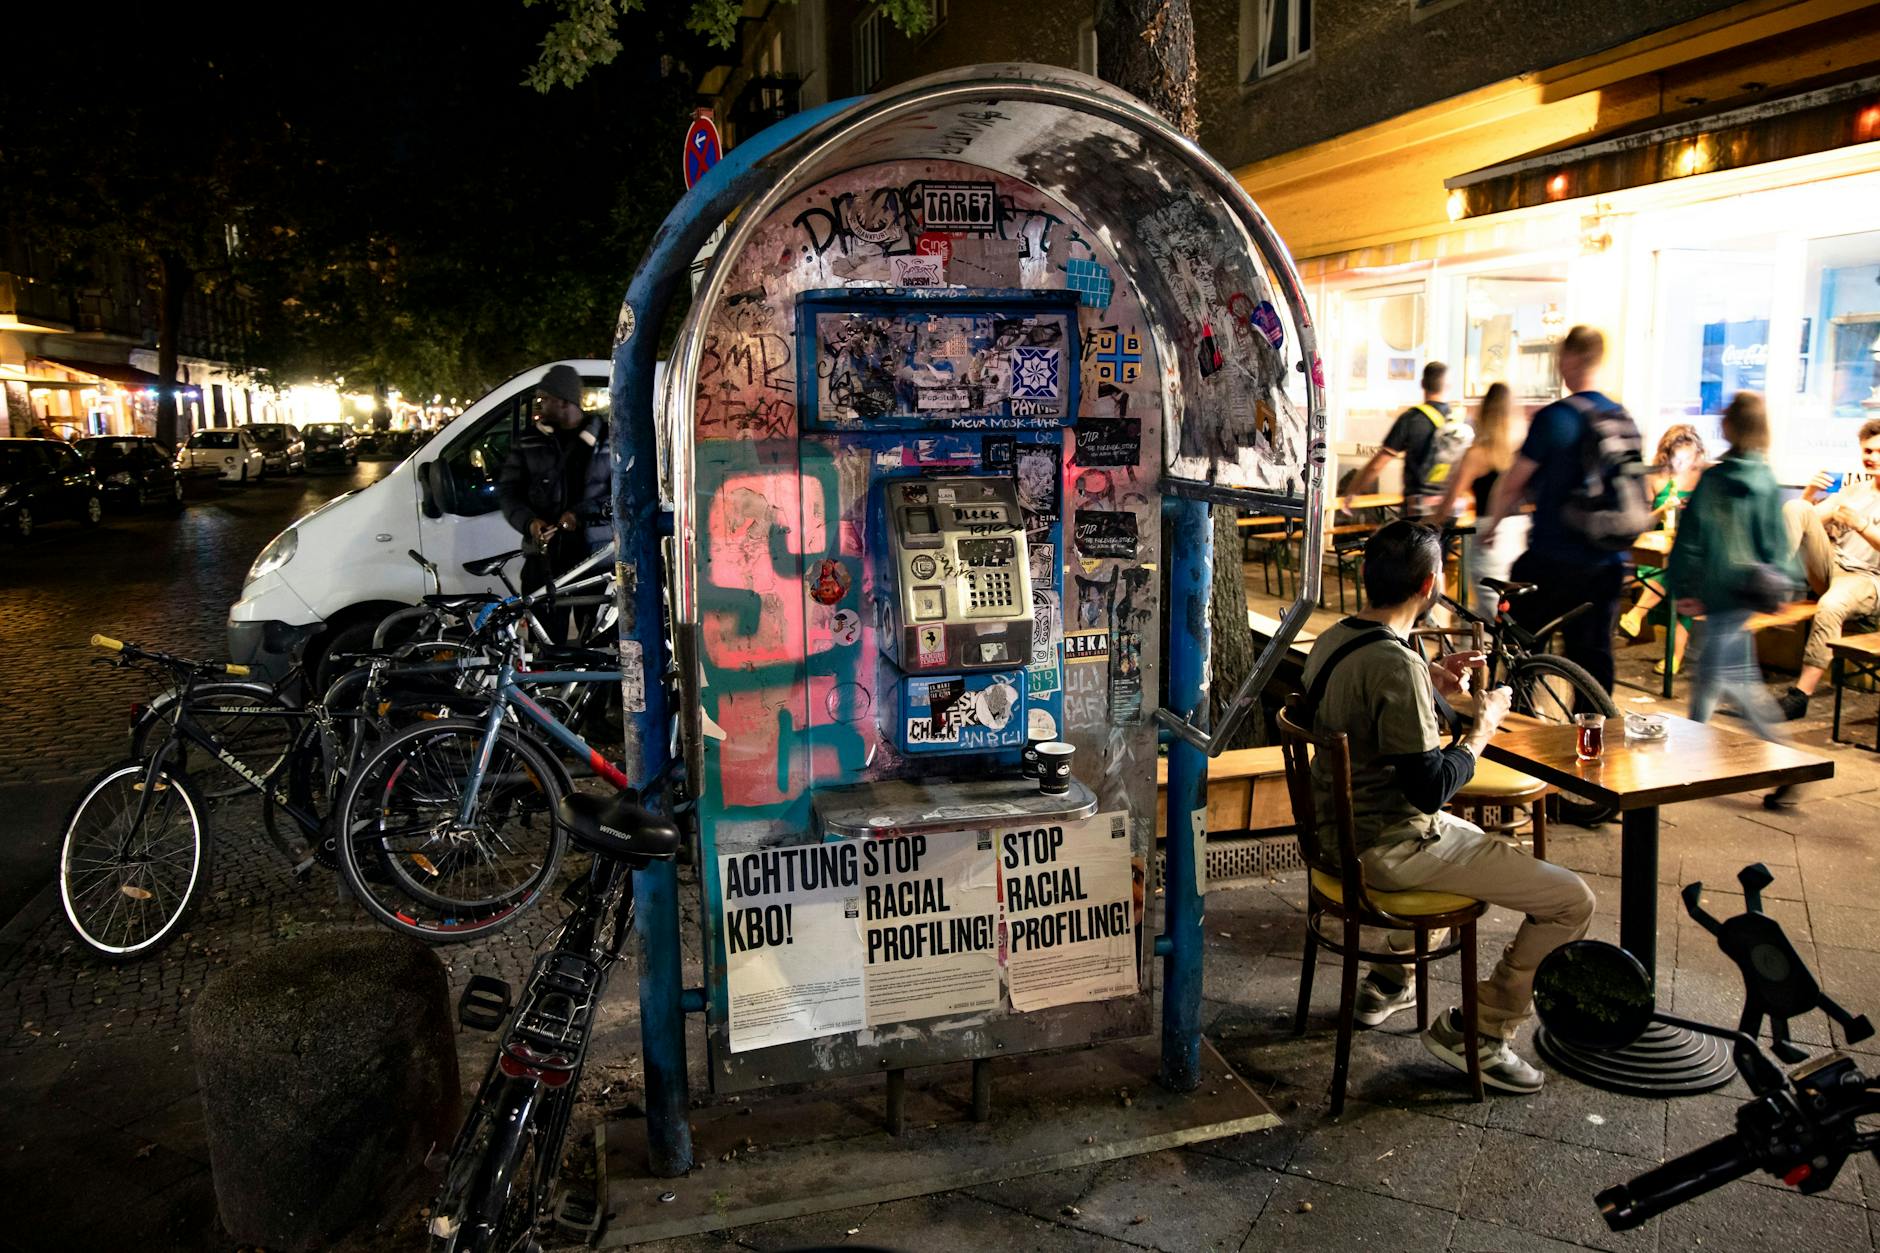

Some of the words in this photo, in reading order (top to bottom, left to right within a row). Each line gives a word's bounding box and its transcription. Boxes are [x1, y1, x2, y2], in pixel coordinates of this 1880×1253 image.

[1065, 635, 1108, 653] REKA
[863, 834, 927, 877] STOP
[1003, 826, 1063, 870] STOP
[726, 843, 859, 901] ACHTUNG
[1006, 866, 1088, 913] RACIAL
[865, 877, 951, 921] RACIAL
[726, 903, 793, 955] KBO!
[867, 914, 994, 965] PROFILING!
[1011, 900, 1131, 954] PROFILING!
